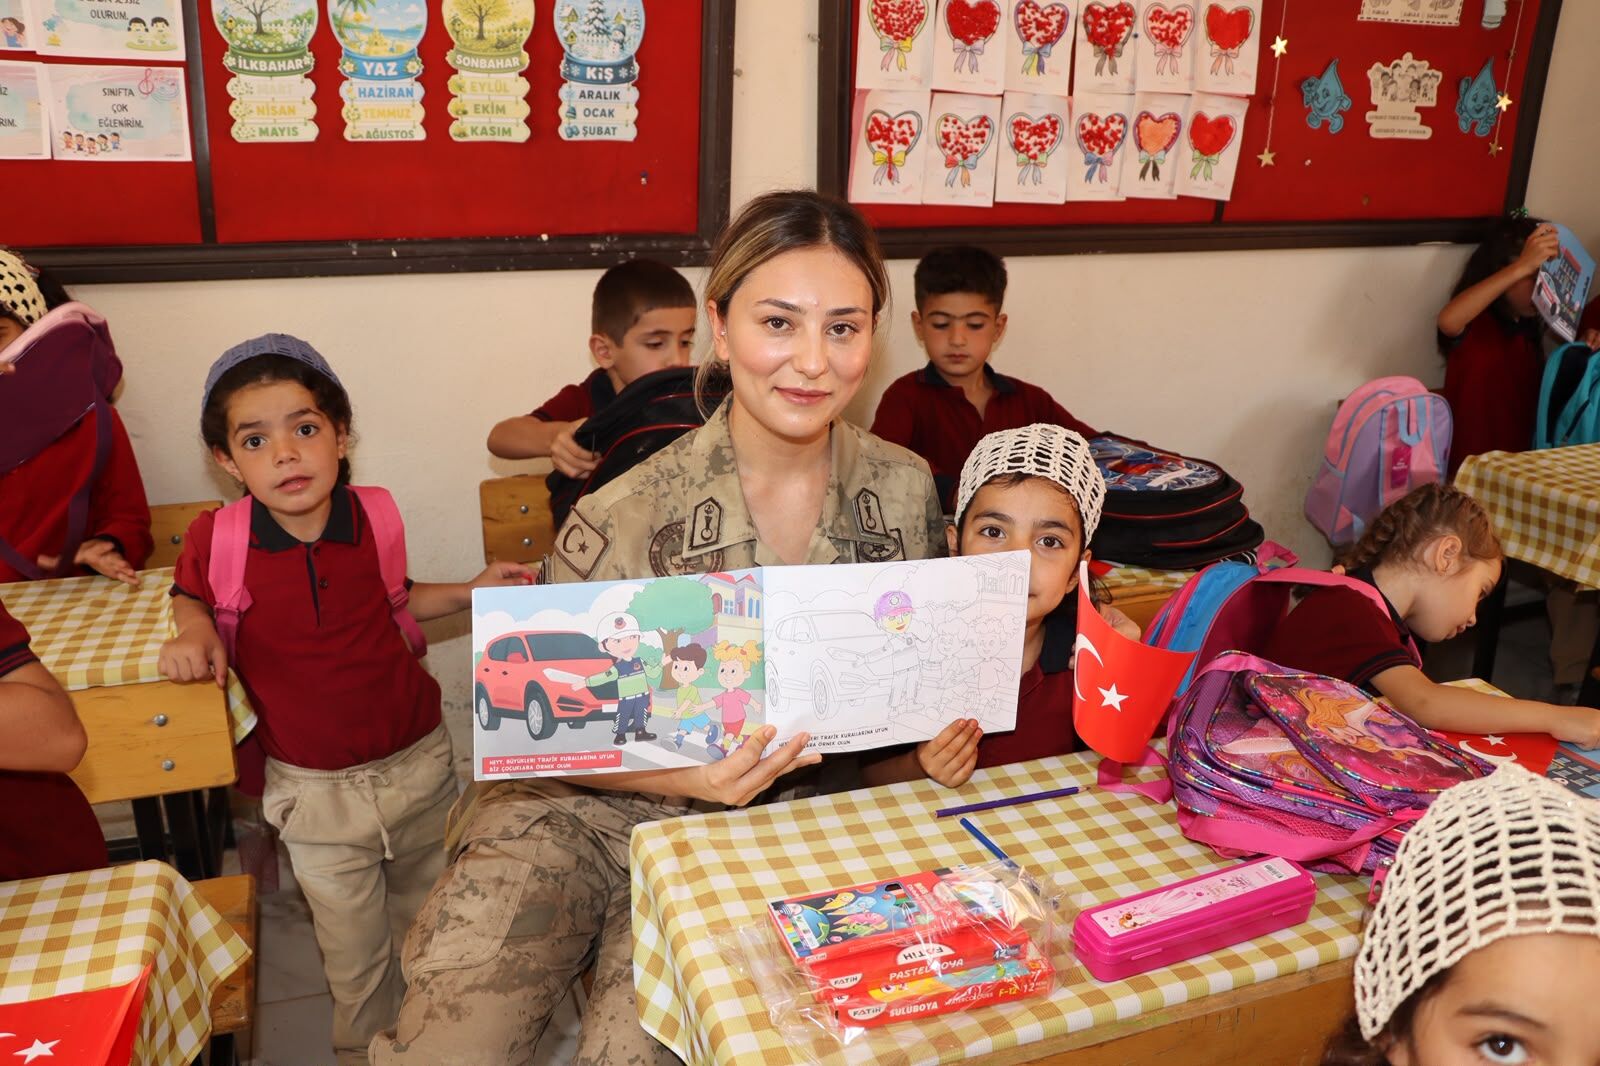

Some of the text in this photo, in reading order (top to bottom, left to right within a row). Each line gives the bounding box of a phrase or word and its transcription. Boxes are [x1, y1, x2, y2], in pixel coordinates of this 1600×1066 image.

[90, 9, 129, 20] OLURUM.
[238, 55, 304, 71] İLKBAHAR
[455, 54, 520, 69] SONBAHAR
[363, 61, 398, 76] YAZ
[102, 87, 136, 97] SINIFTA
[358, 84, 414, 98] HAZİRAN
[470, 80, 511, 93] EYLÜL
[579, 89, 621, 101] ARALIK
[111, 103, 129, 113] ÇOK
[256, 102, 297, 116] NİSAN
[363, 107, 412, 119] TEMMUZ
[473, 101, 507, 115] EKİM
[583, 107, 615, 118] OCAK
[258, 126, 300, 137] MAYIS
[366, 128, 415, 140] AĞUSTOS
[470, 126, 513, 137] KASIM
[582, 126, 617, 138] ŞUBAT
[889, 958, 965, 981] PASTELOYA
[889, 1001, 939, 1017] SULUBOYA
